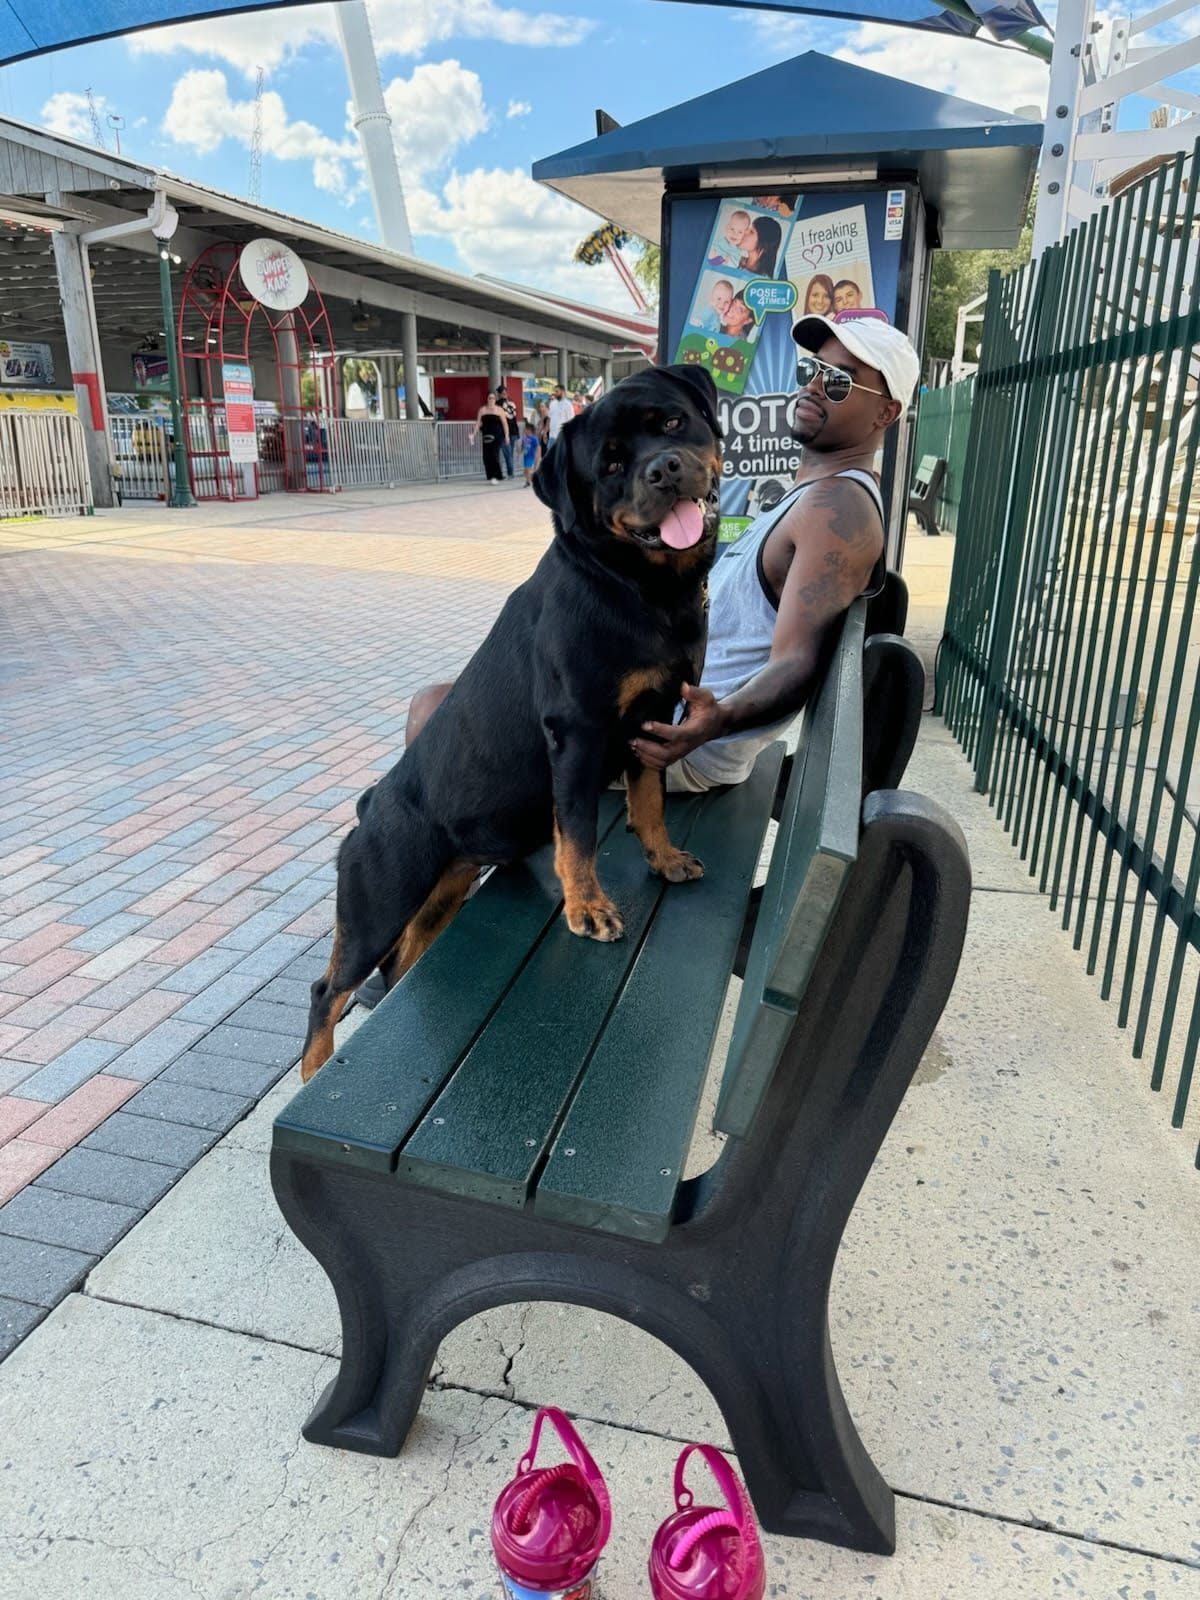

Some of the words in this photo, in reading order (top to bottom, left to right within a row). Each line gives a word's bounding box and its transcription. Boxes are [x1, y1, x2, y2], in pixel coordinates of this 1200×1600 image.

[801, 231, 805, 247] I
[809, 222, 858, 245] freaking
[826, 238, 853, 261] you
[750, 288, 777, 298] POSE
[730, 435, 743, 453] 4
[748, 434, 803, 452] times
[739, 453, 801, 473] online
